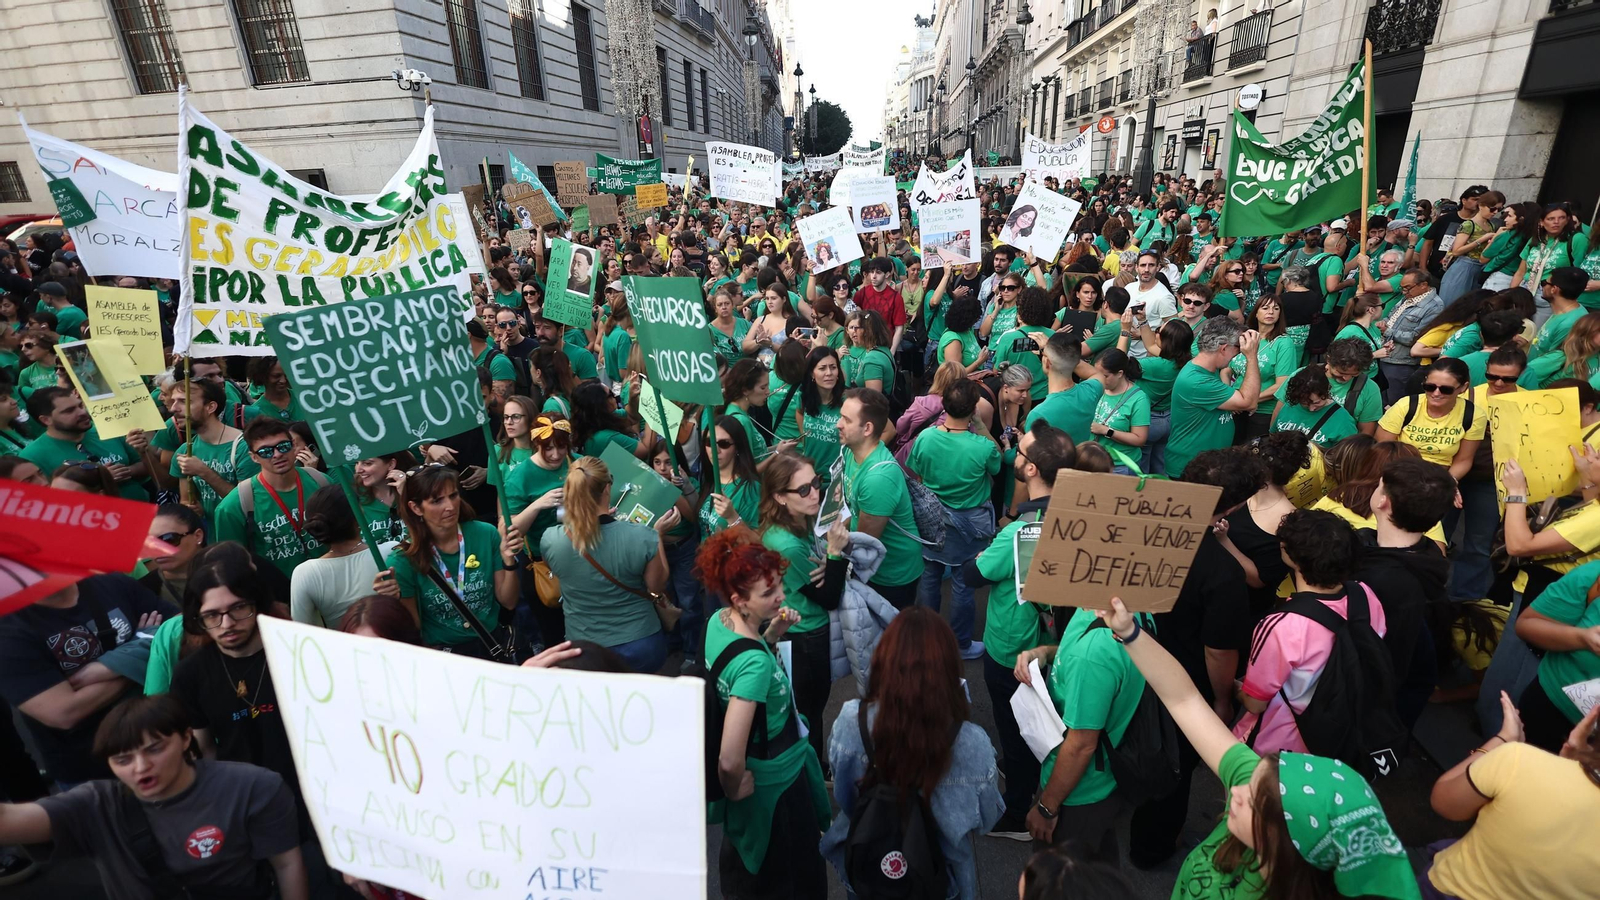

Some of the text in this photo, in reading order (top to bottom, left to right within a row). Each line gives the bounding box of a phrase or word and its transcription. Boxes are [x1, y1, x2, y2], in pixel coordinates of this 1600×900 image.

[714, 158, 727, 166] IES
[1038, 152, 1078, 167] PÚBLICA
[187, 167, 241, 224] DE
[276, 273, 327, 307] LA
[341, 243, 468, 300] PÚBLICA
[95, 300, 151, 312] ASAMBLEA de
[102, 311, 151, 323] PROFESORES
[279, 289, 464, 351] SEMBRAMOS
[96, 326, 112, 336] IES
[290, 318, 468, 386] EDUCACIÓN
[299, 342, 477, 414] COSECHAMOS
[1407, 425, 1462, 436] EDUCACIÓN
[1409, 433, 1457, 445] ESPECIAL
[1075, 492, 1192, 519] LA PÚBLICA
[1050, 518, 1202, 550] NO SE VENDE
[1038, 548, 1190, 589] SE DEFIENDE
[276, 630, 654, 752] YO EN VERANO
[302, 705, 594, 809] A 40 GRADOS
[314, 777, 329, 816] Y
[479, 820, 523, 861] EN
[547, 827, 597, 860] SU
[331, 824, 446, 890] OFICINA
[527, 866, 609, 893] AIRE
